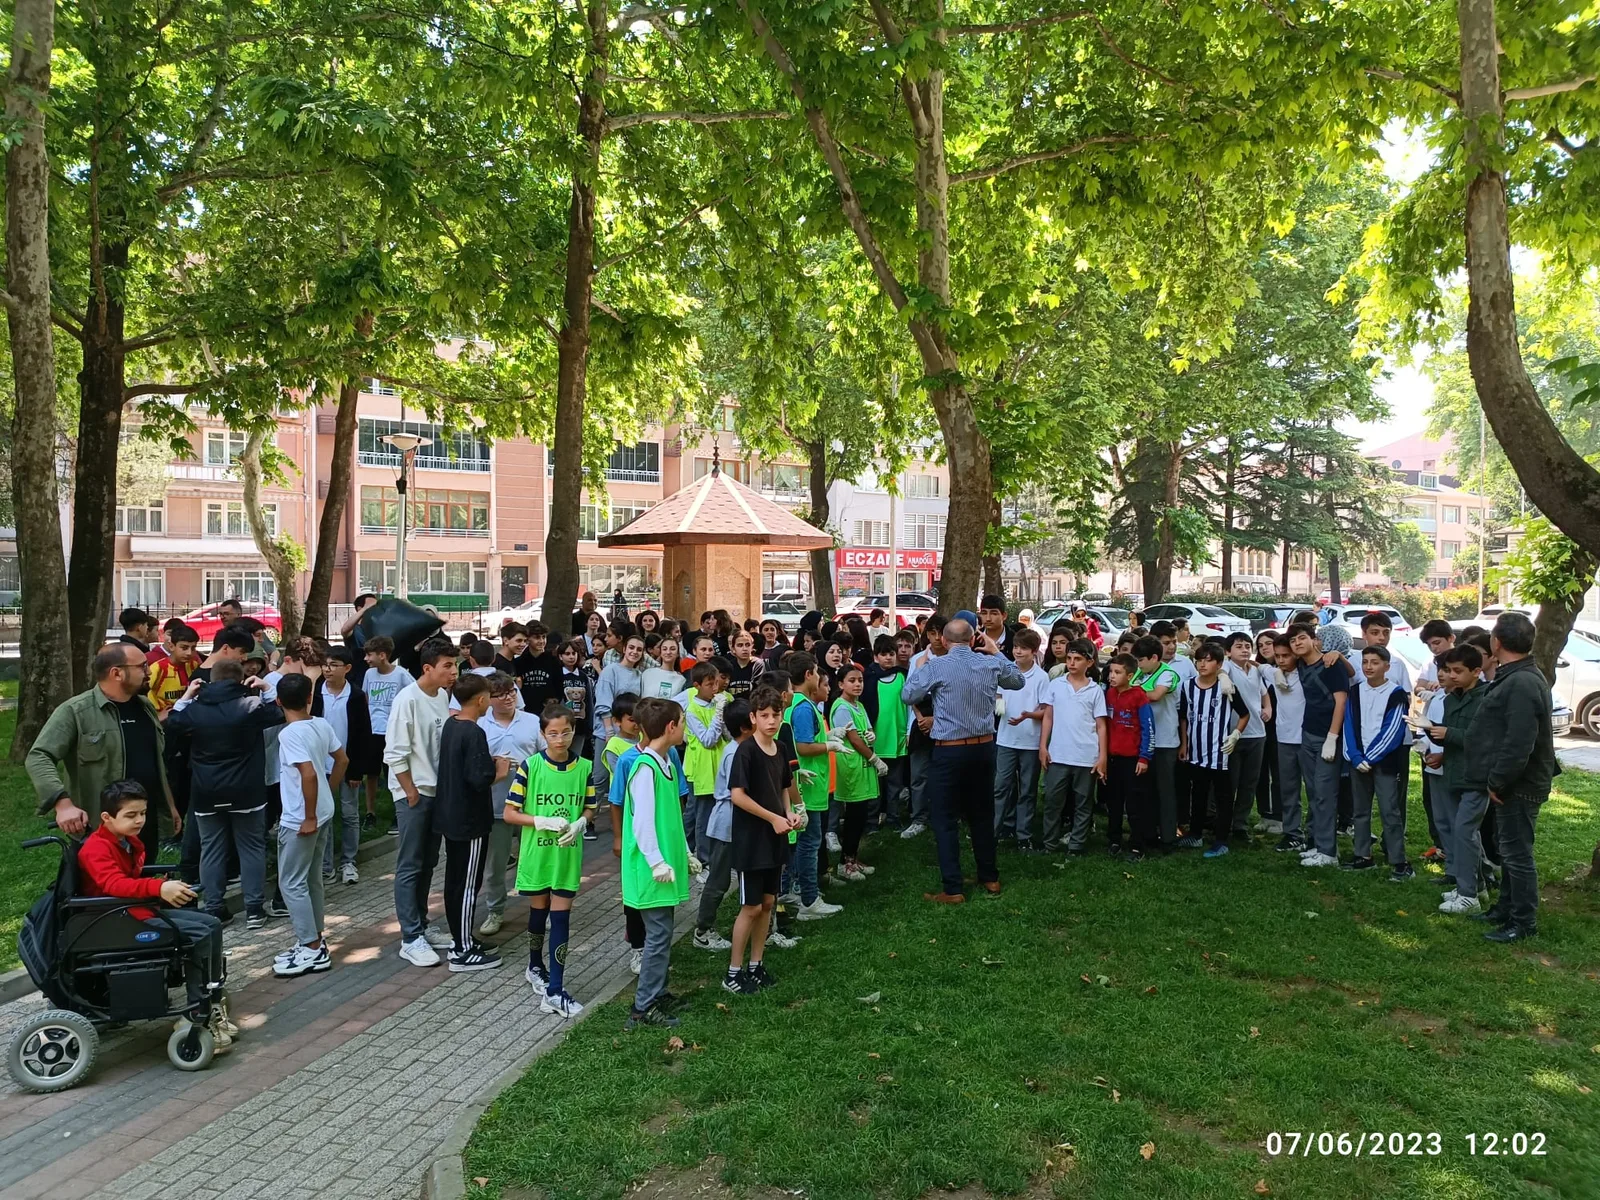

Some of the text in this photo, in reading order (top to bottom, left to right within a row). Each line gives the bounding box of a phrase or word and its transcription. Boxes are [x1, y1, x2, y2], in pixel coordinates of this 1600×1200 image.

[845, 552, 905, 566] ECZAE
[536, 793, 565, 806] EKO
[537, 837, 553, 847] Eco
